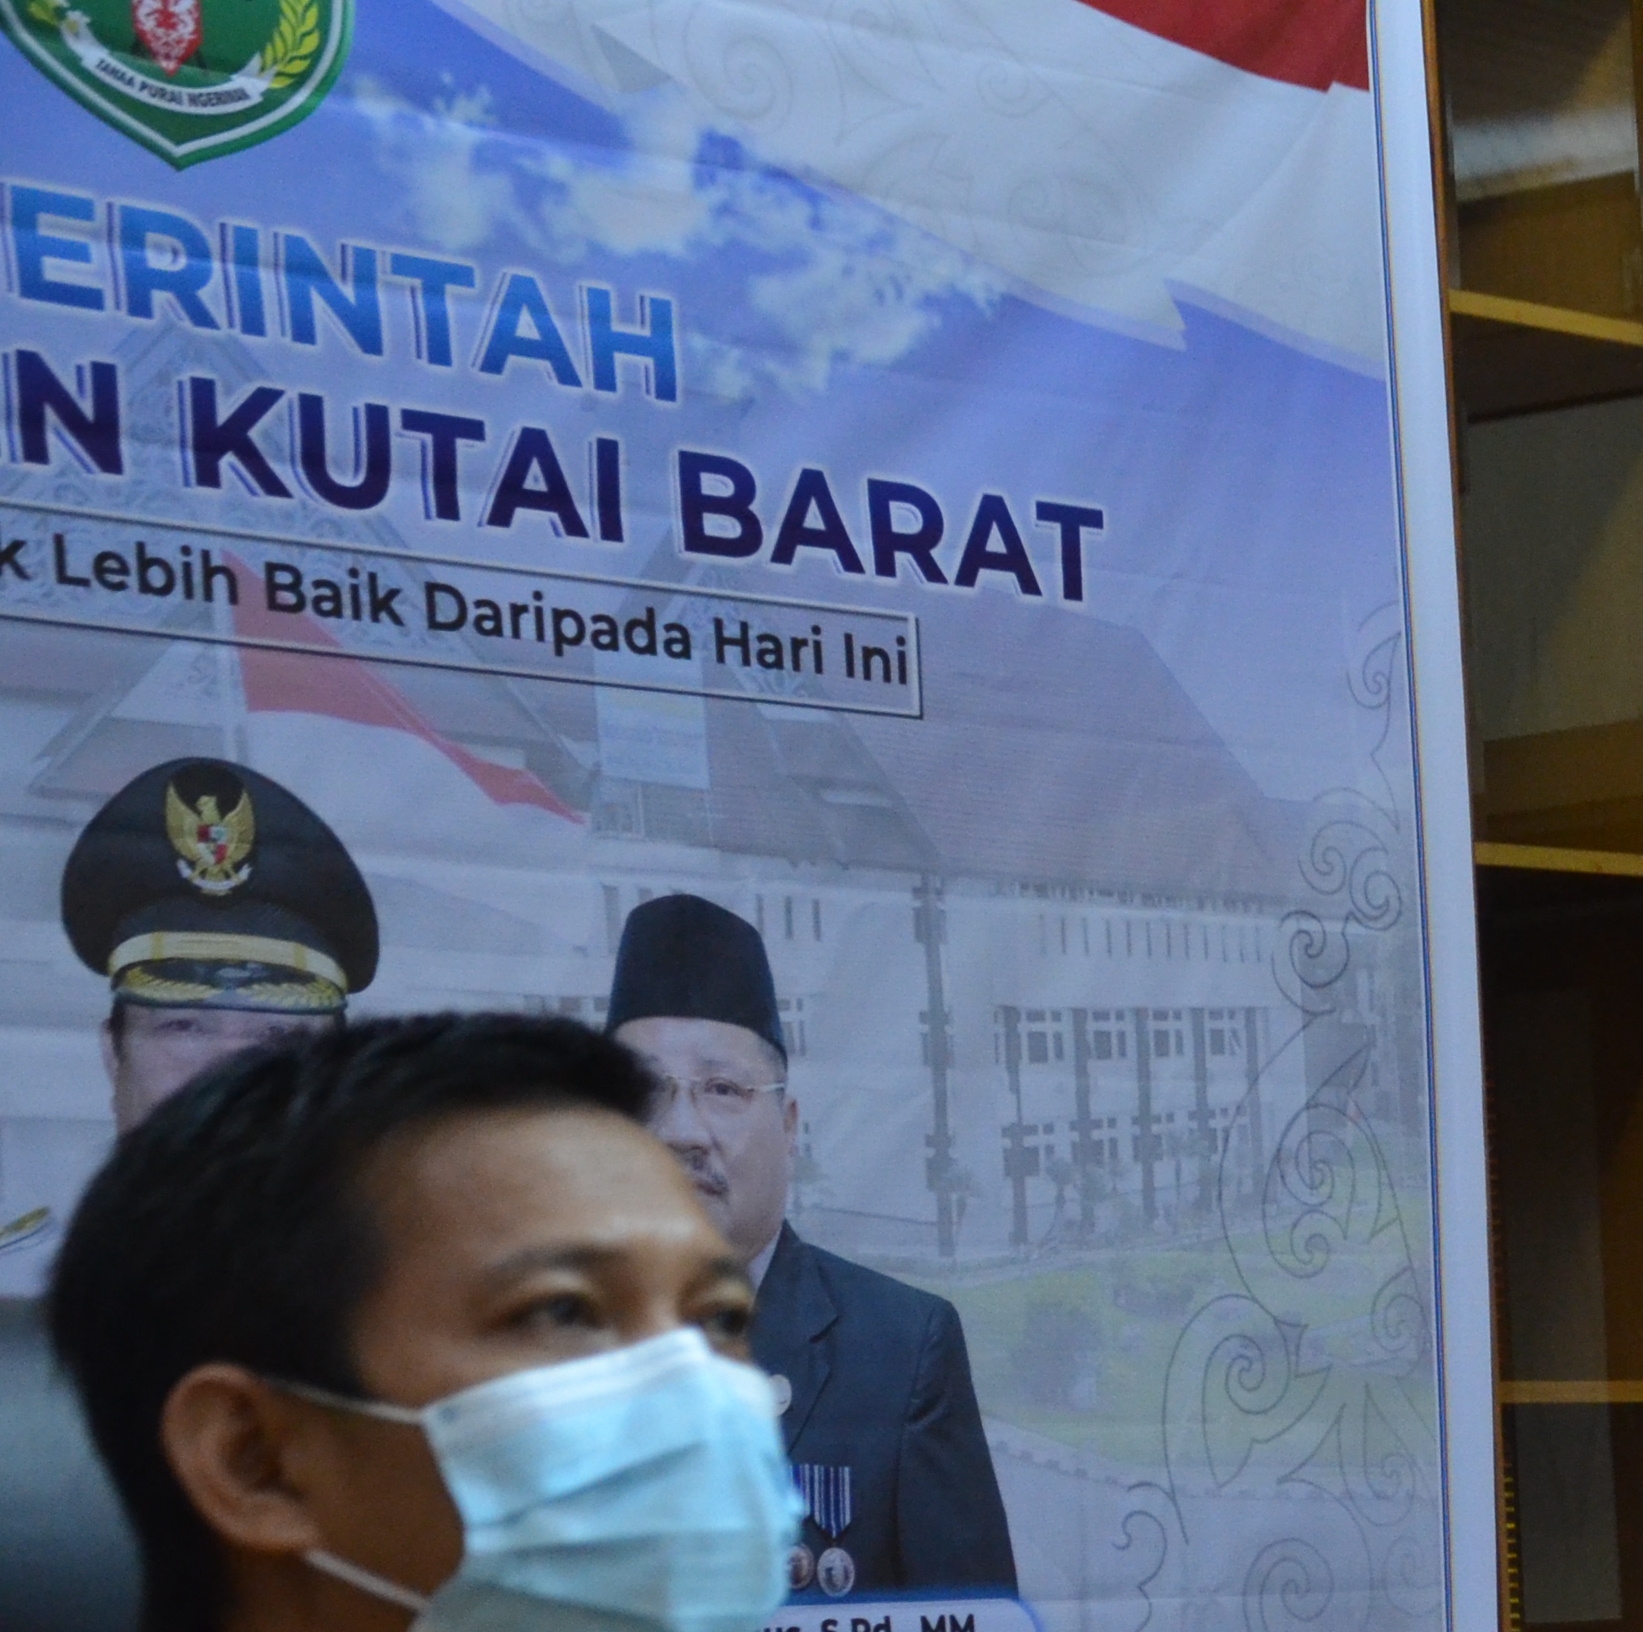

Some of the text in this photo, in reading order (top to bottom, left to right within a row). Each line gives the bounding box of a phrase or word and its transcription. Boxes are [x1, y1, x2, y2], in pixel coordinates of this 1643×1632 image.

[178, 376, 625, 544] KUTAI
[674, 449, 1105, 602] BARAT
[53, 532, 240, 606] Lebih
[263, 560, 406, 628] Baik
[423, 580, 693, 660] Daripada
[713, 616, 824, 675] Hari
[843, 631, 909, 686] Ini
